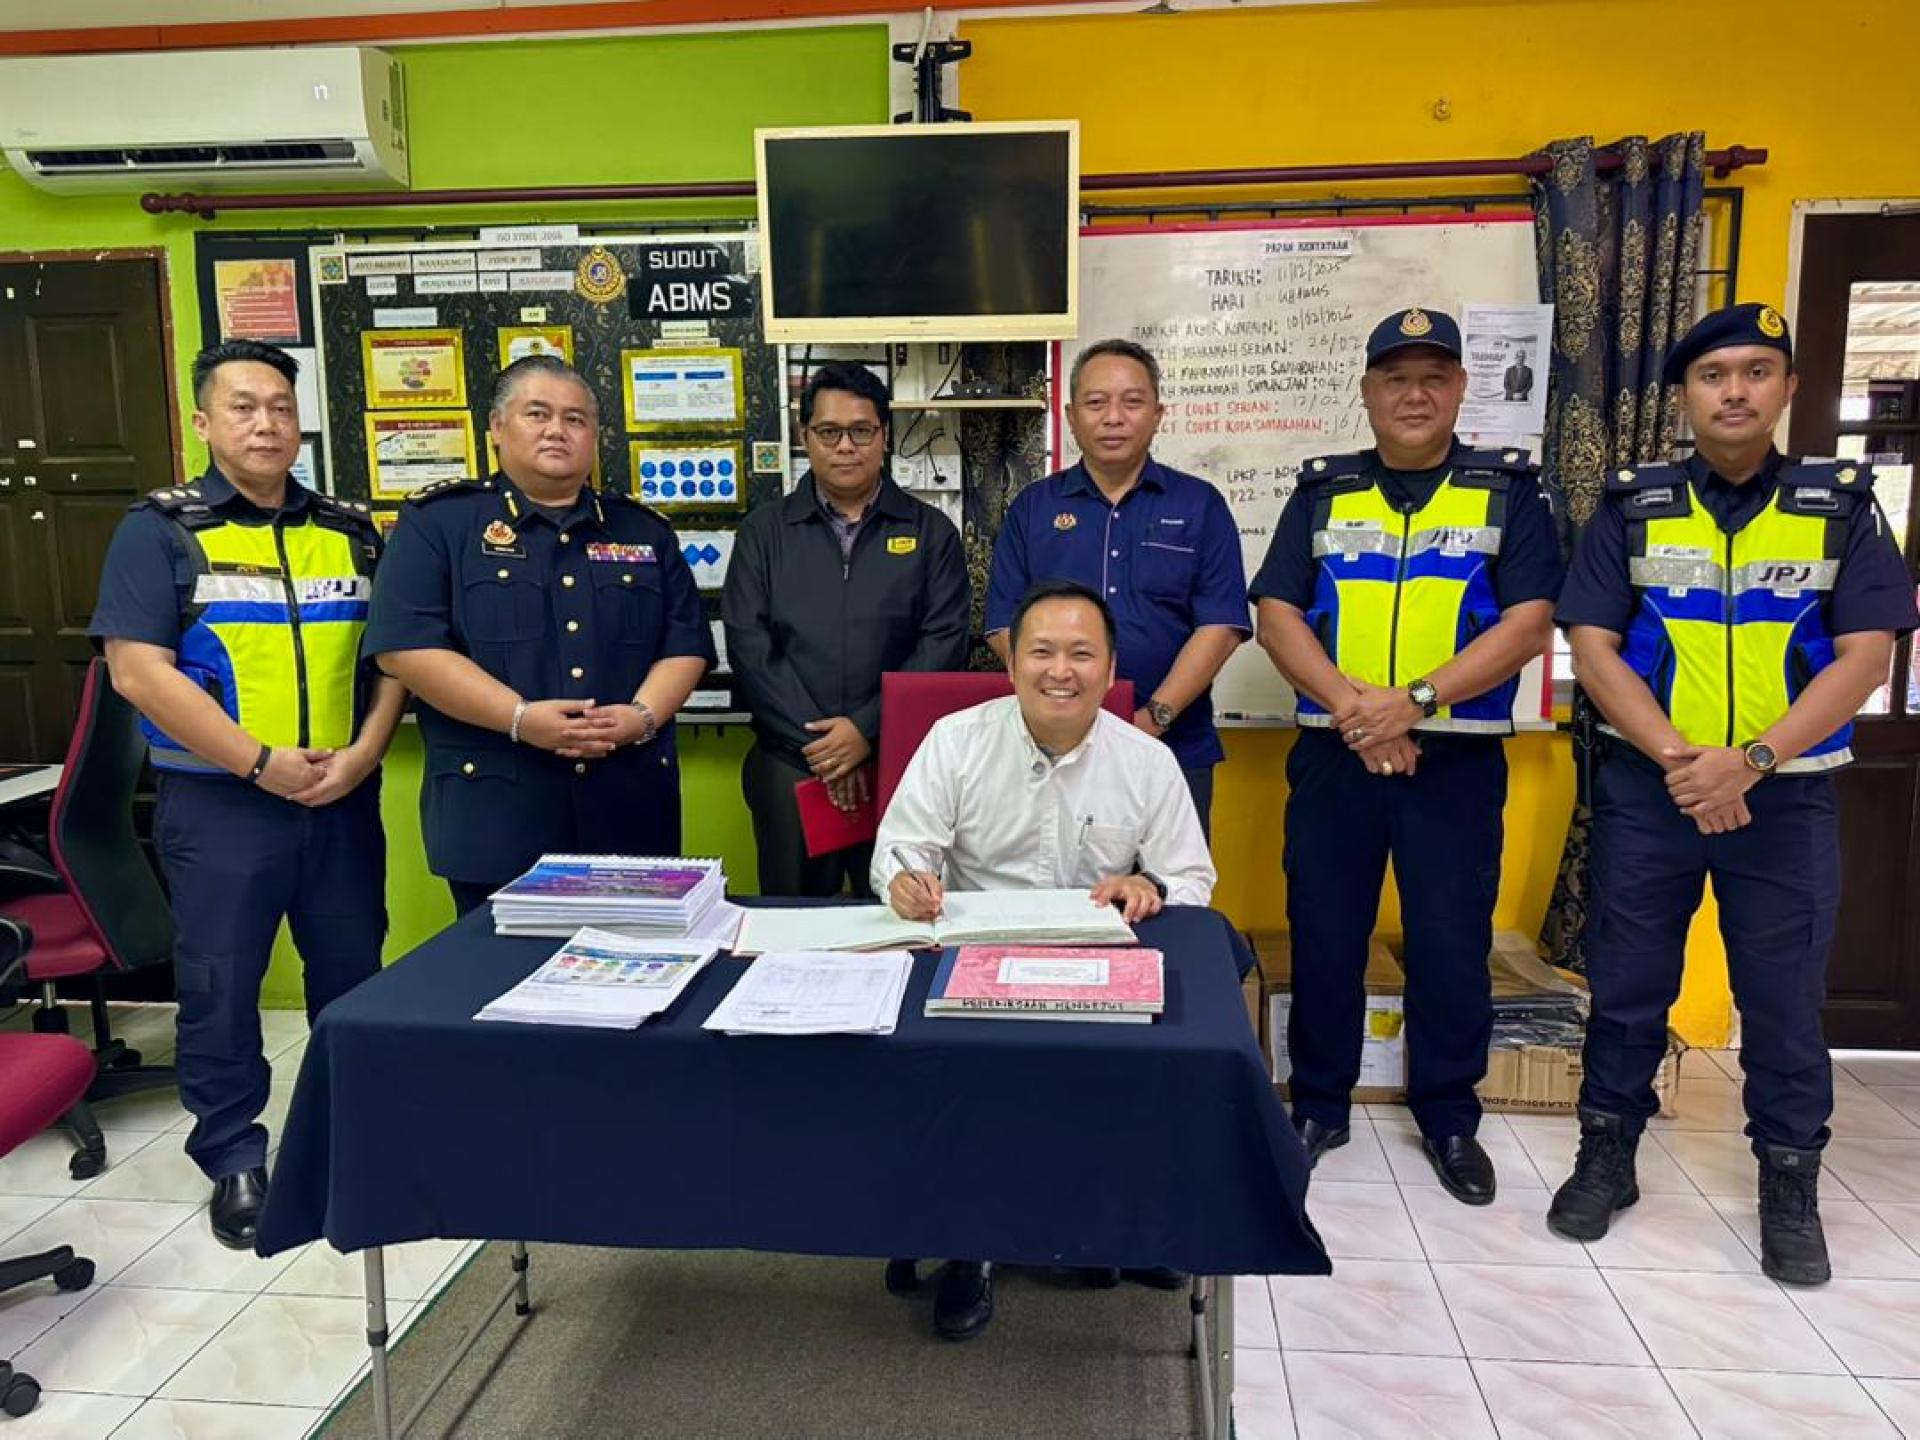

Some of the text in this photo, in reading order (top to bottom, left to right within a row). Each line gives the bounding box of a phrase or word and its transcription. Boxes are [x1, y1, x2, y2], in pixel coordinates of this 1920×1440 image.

[648, 249, 720, 269] SUDUT
[1205, 267, 1262, 288] TARIKH:
[648, 282, 732, 313] ABMS
[1211, 293, 1244, 311] HARI
[1758, 565, 1814, 583] JPJ
